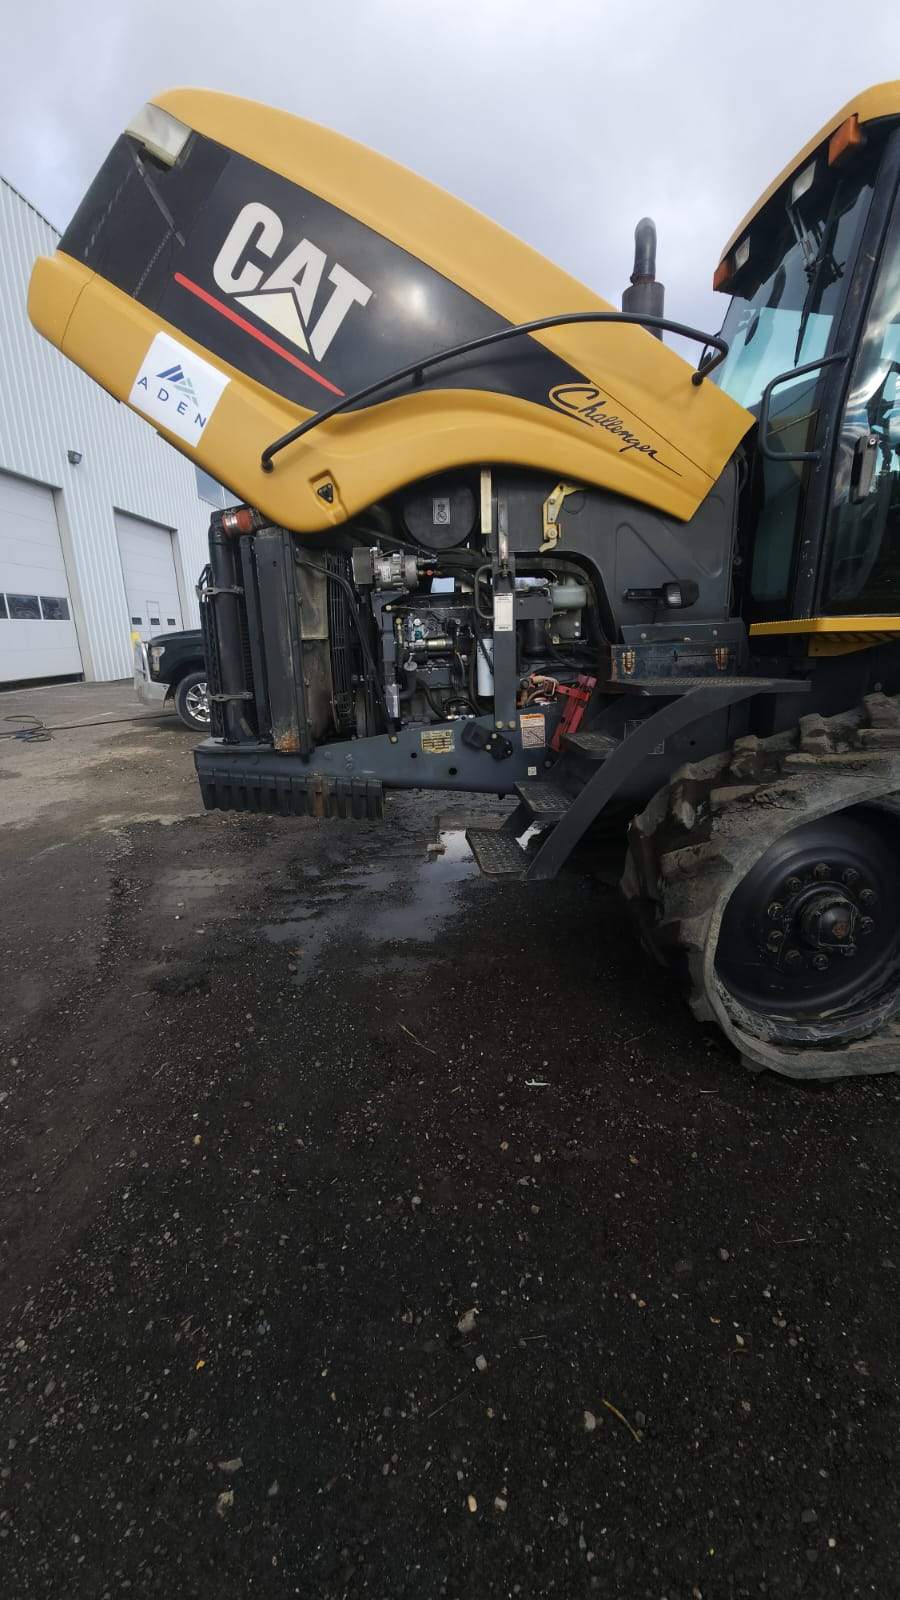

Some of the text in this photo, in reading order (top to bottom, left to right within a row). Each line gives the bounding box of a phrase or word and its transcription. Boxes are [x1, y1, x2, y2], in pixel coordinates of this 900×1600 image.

[213, 202, 373, 362] CAT
[137, 376, 207, 427] ADEN
[548, 382, 682, 477] Challenger
